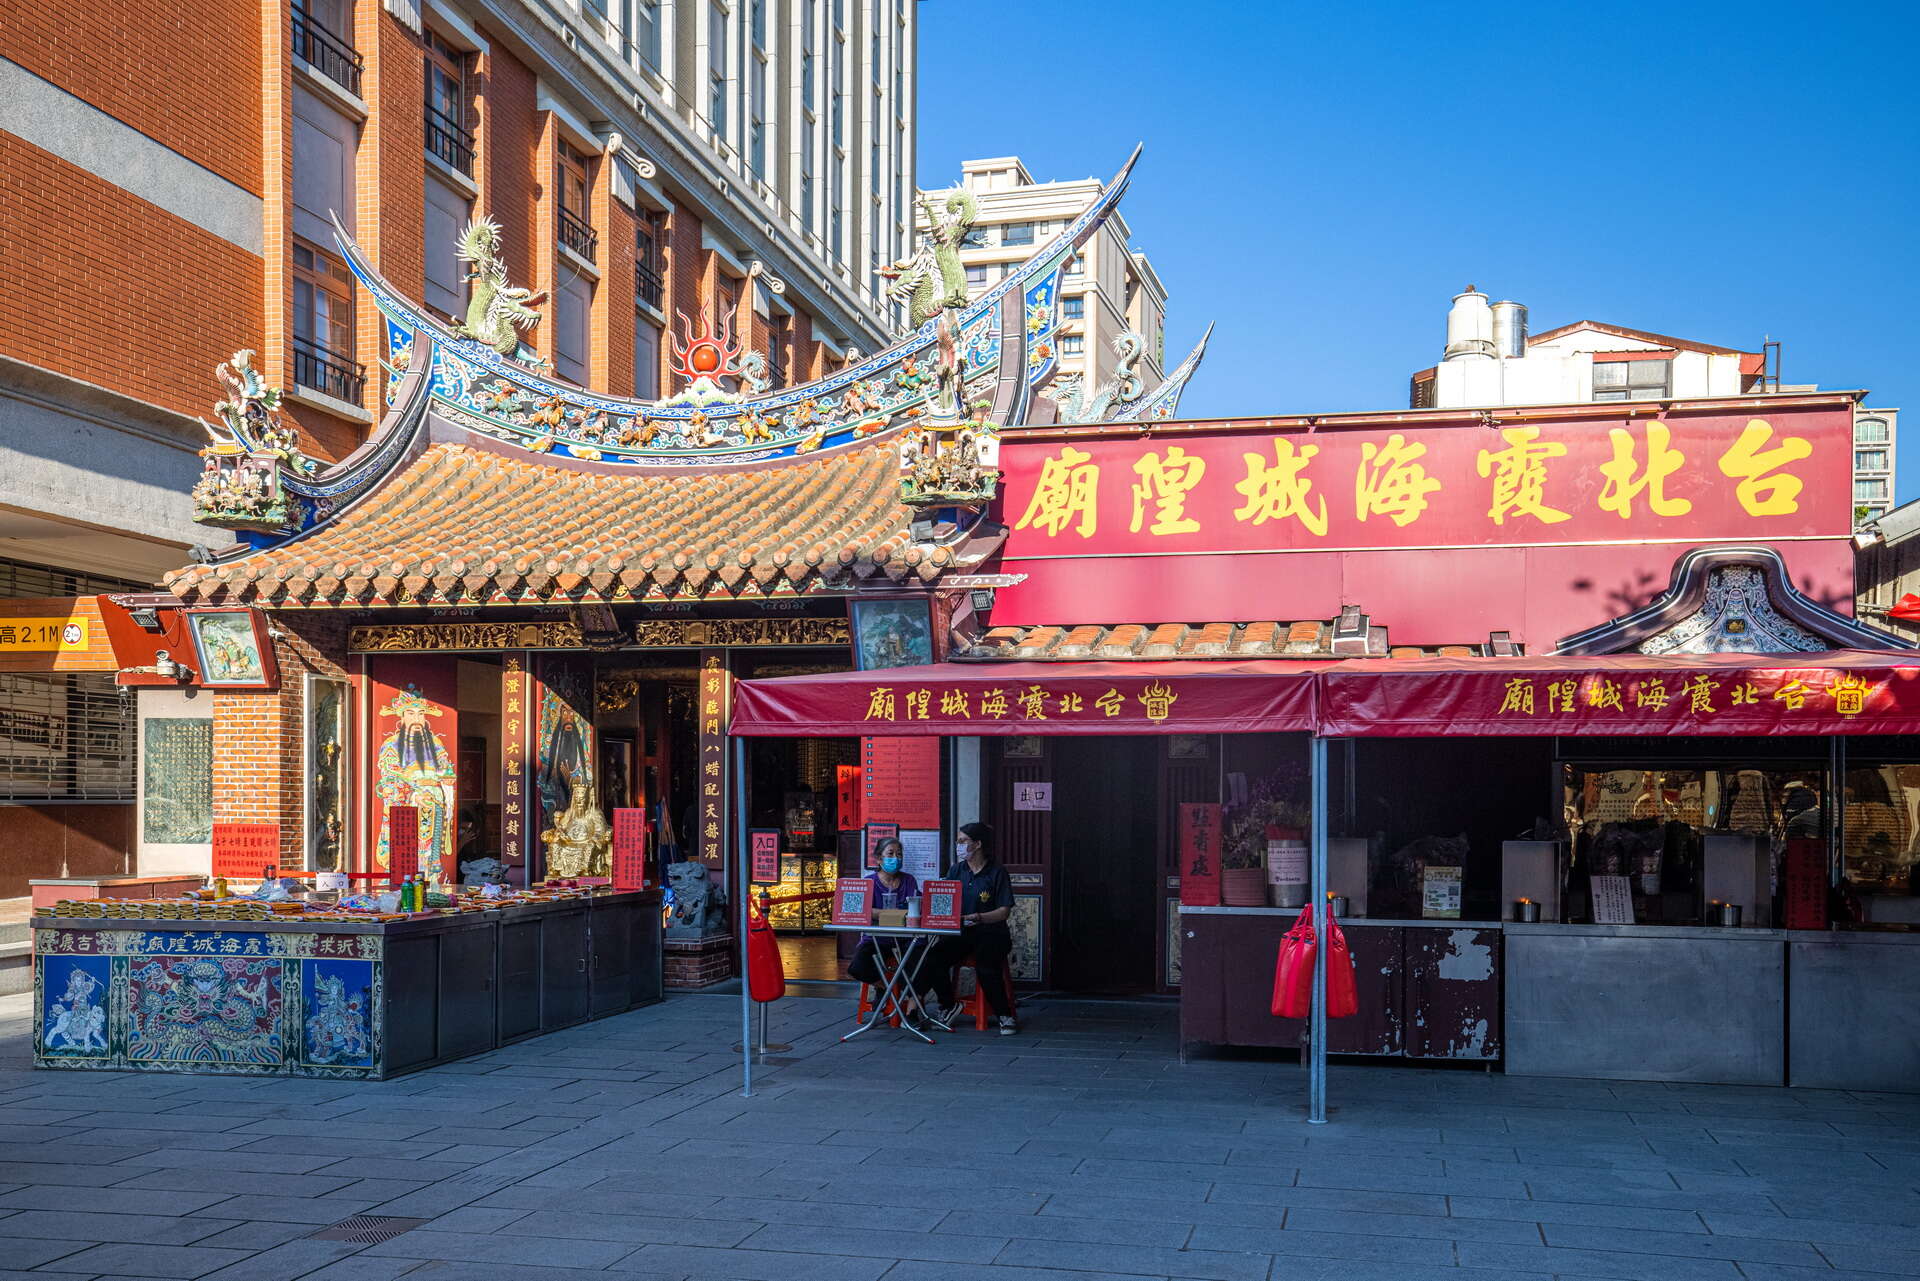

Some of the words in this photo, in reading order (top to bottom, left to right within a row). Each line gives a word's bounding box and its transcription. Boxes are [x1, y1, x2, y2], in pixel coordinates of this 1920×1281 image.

[1020, 787, 1045, 802] 出口
[756, 837, 775, 849] 入口
[321, 880, 344, 888] 入口
